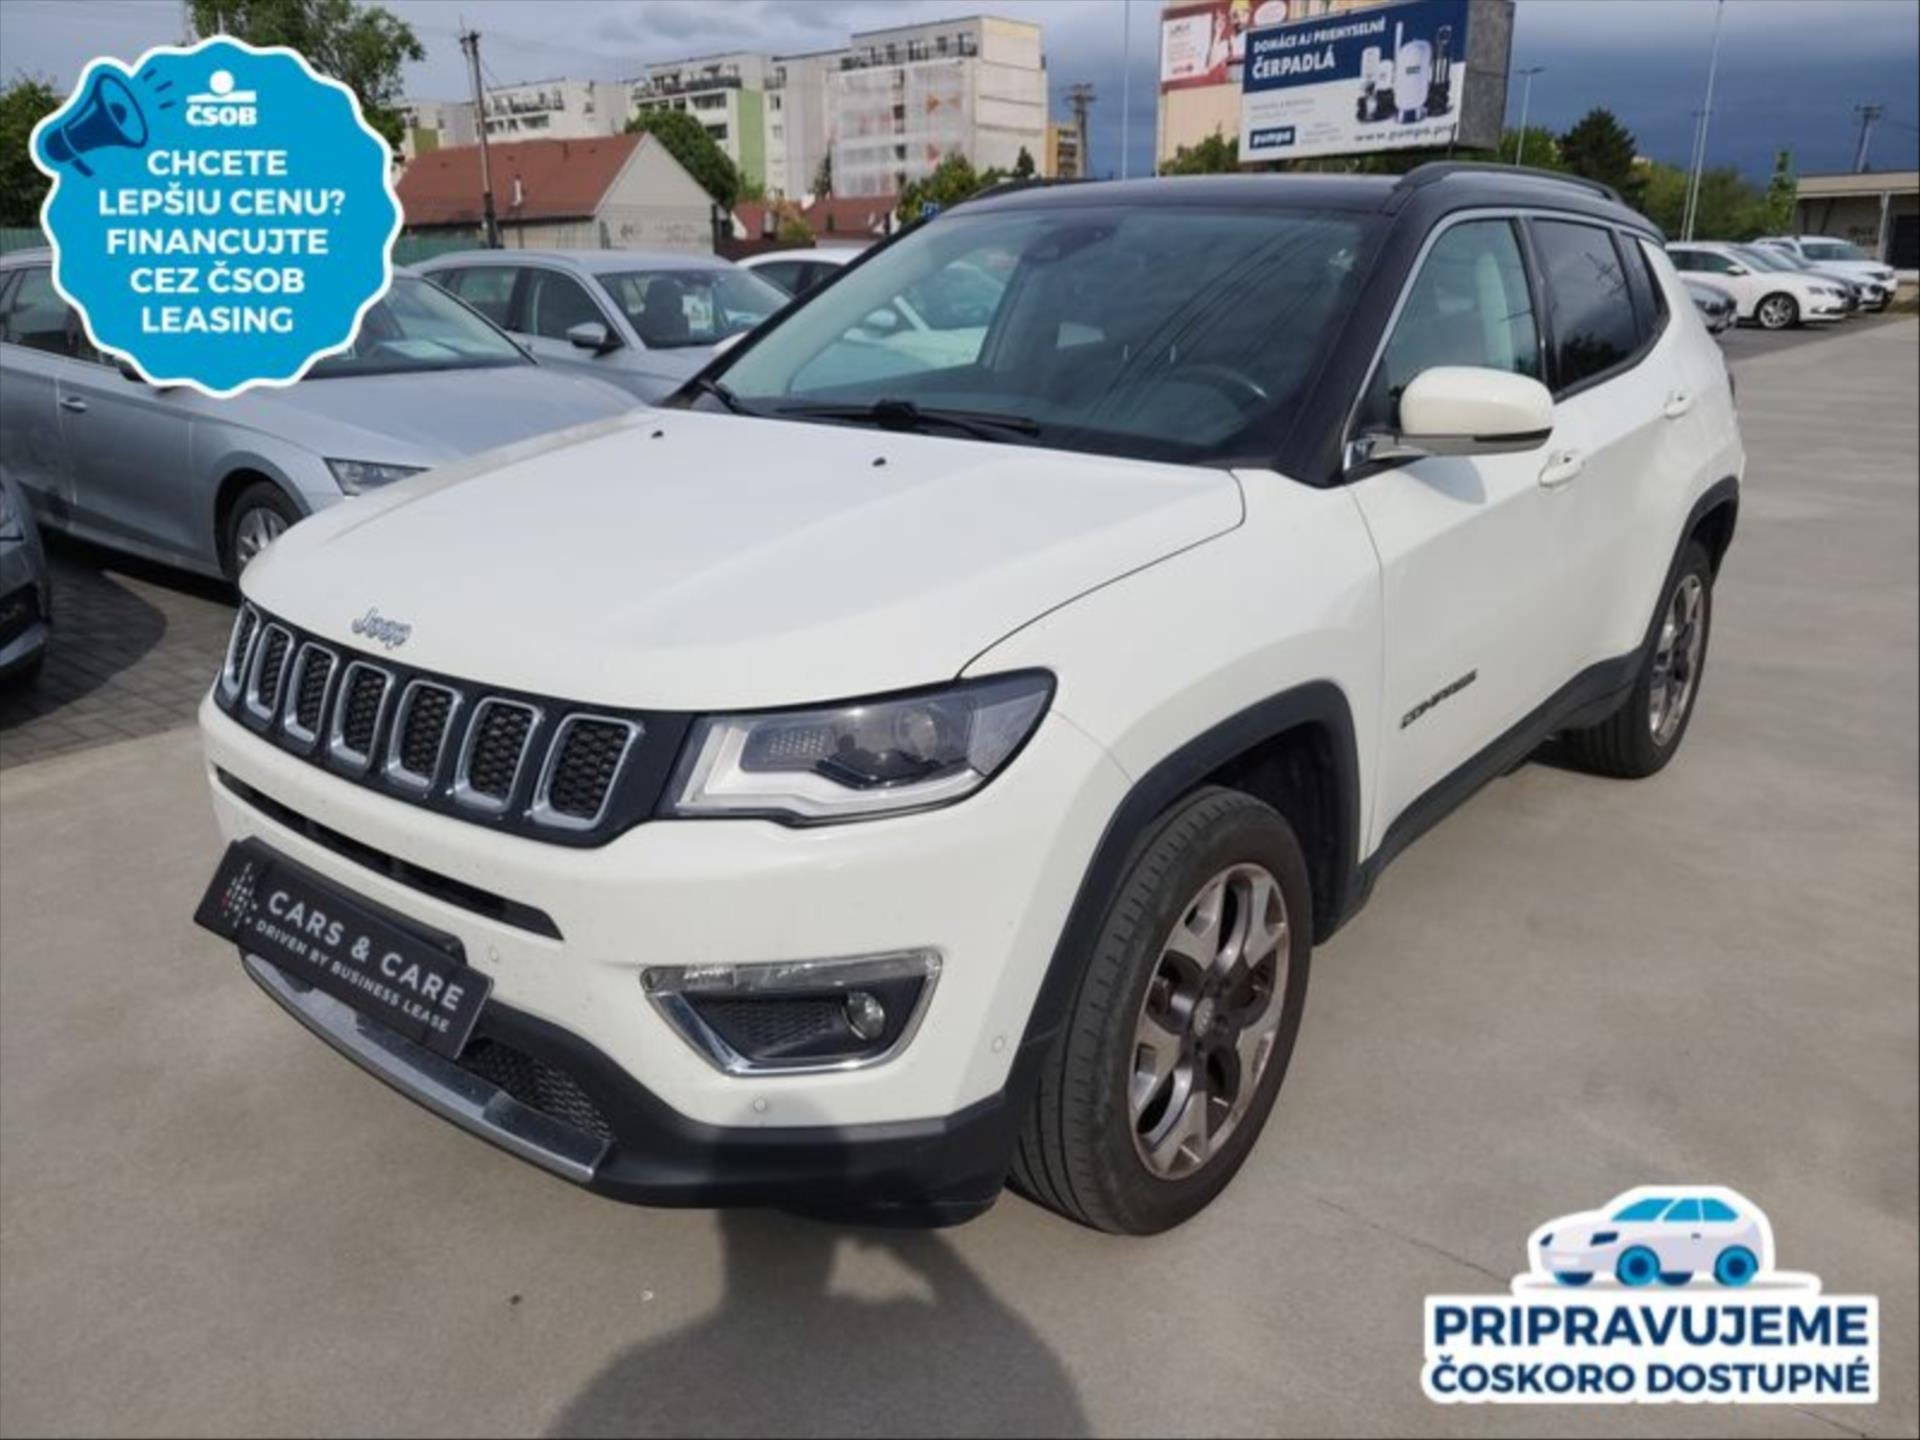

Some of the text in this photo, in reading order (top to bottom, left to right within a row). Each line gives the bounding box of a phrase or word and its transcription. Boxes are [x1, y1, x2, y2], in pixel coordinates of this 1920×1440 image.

[1298, 31, 1313, 46] AJ
[1314, 16, 1386, 43] PRIEMYSELNÉ
[1252, 44, 1335, 79] ČERPADLÁ
[352, 606, 412, 650] Jeep
[268, 891, 464, 1012] CARS & CARE
[256, 919, 450, 1033] DRIVEN BY BUSINESS LEASE
